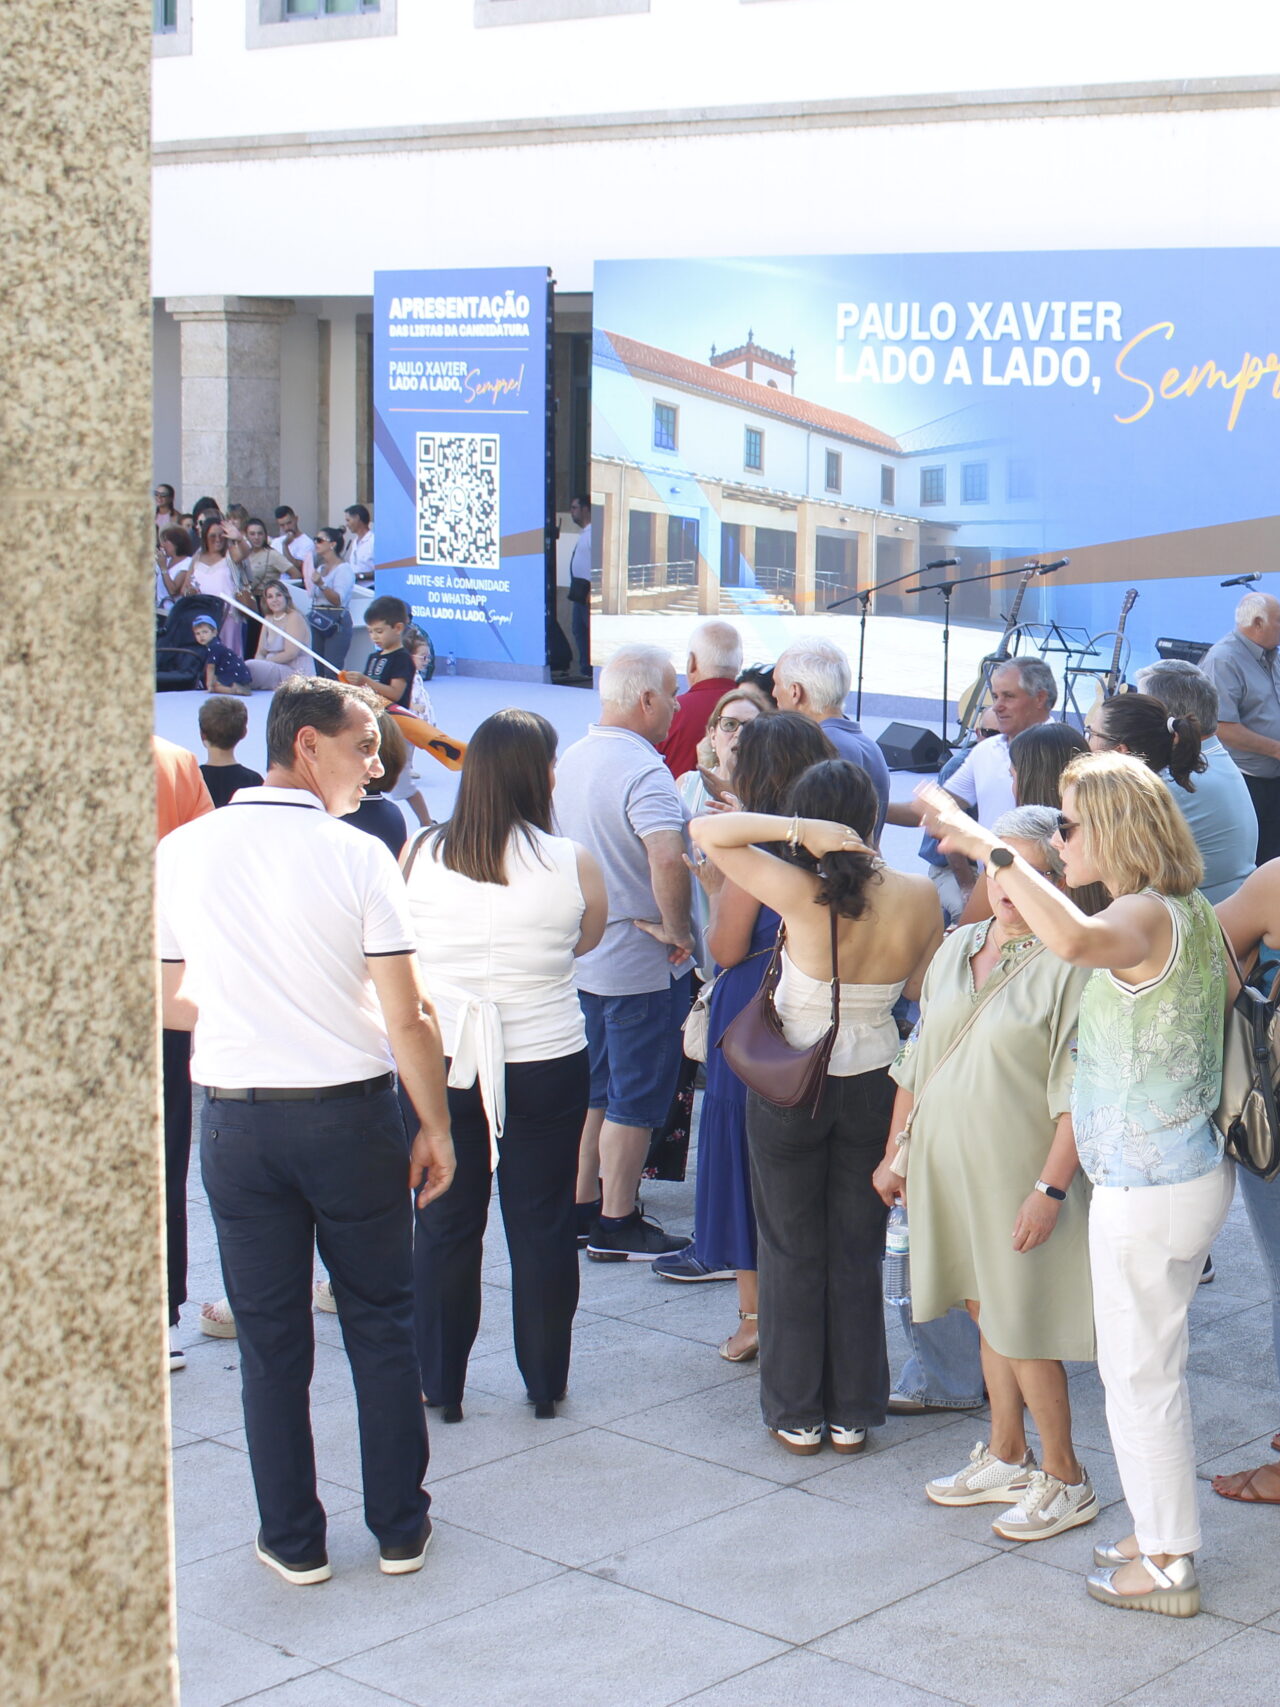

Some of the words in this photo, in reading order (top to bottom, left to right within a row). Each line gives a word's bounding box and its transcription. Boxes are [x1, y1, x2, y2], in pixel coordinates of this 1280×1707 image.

[389, 290, 530, 323] APRESENTAÇÃO
[389, 324, 409, 337] DAS
[409, 324, 444, 337] LISTAS
[444, 324, 458, 337] DA
[458, 323, 530, 337] CANDIDATURA
[836, 301, 957, 341] PAULO
[965, 301, 1123, 342] XAVIER
[389, 360, 424, 376] PAULO
[425, 361, 468, 376] XAVIER
[835, 346, 935, 385] LADO
[944, 346, 972, 385] A
[982, 346, 1101, 395] LADO,
[389, 376, 419, 391] LADO
[420, 376, 429, 391] A
[429, 376, 463, 394] LADO,
[464, 363, 525, 405] Sempre!
[406, 574, 445, 588] JUNTE-SE
[453, 577, 511, 593] COMUNIDADE
[428, 591, 441, 603] DO
[441, 592, 488, 607] WHATSAPP
[411, 605, 431, 618] SIGA
[431, 606, 455, 620] LADO
[455, 609, 462, 620] A
